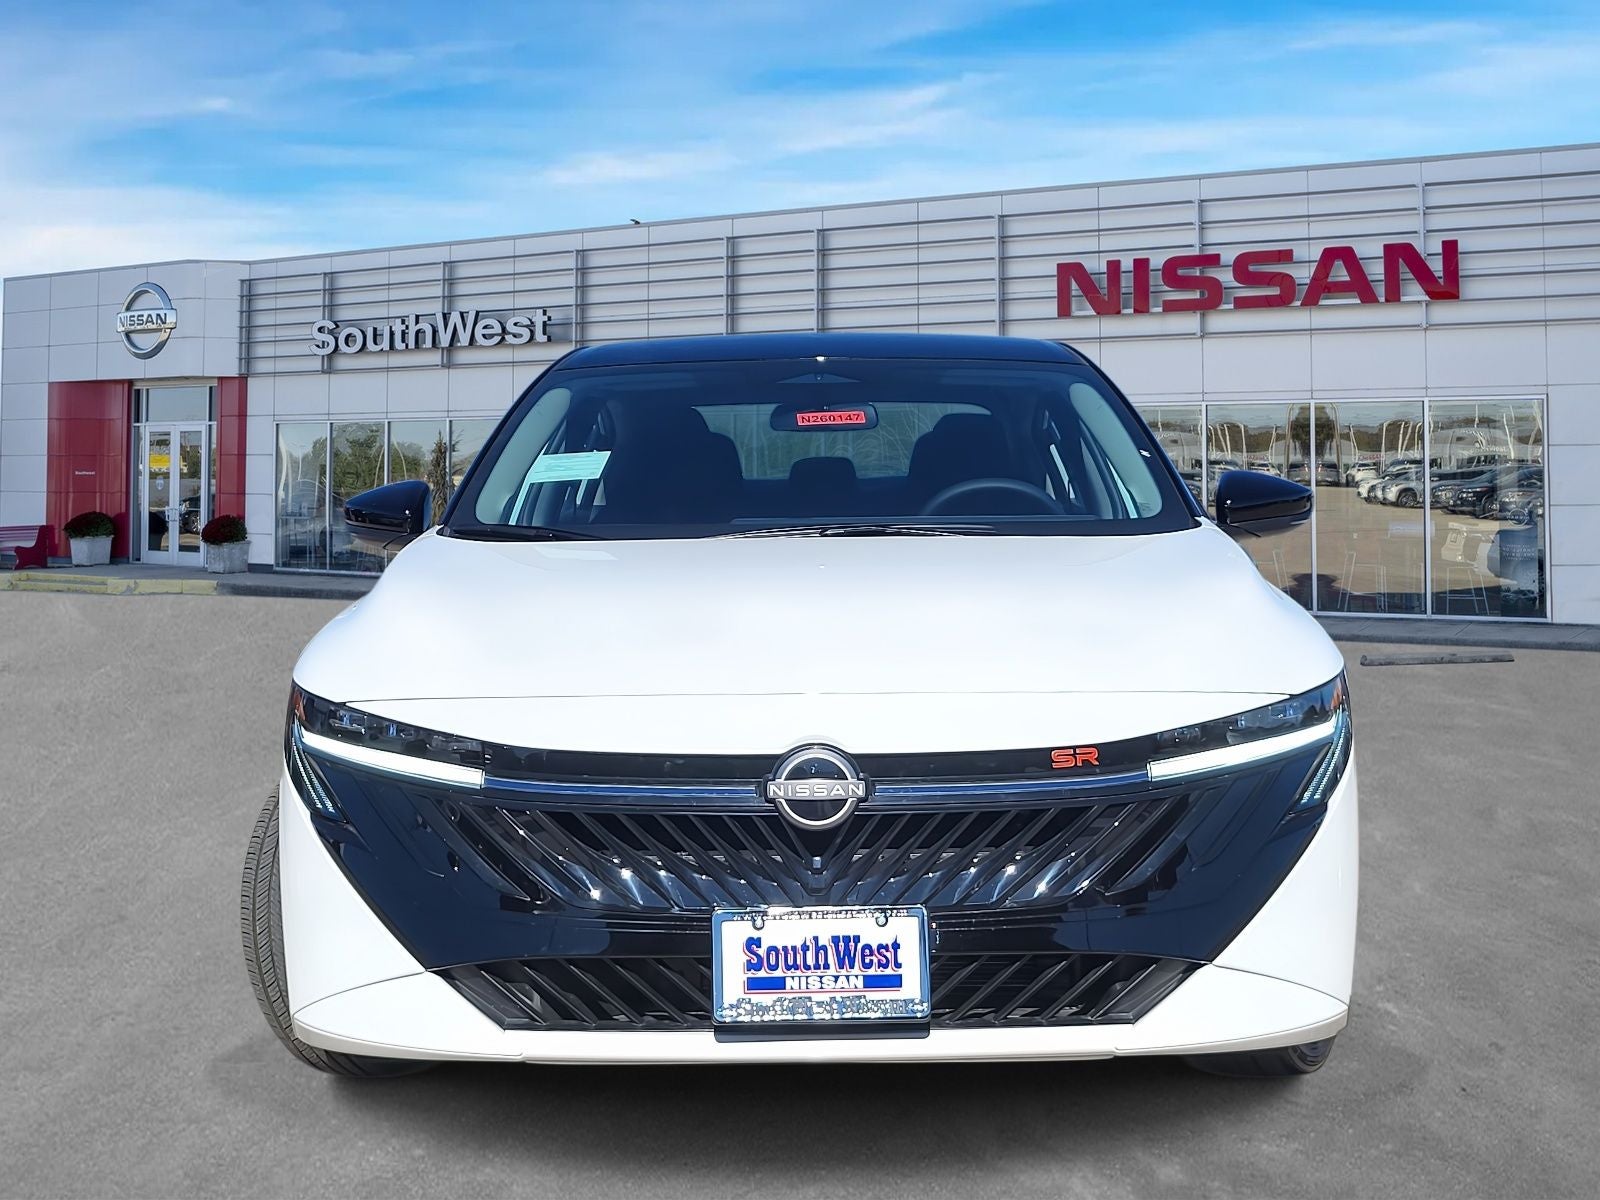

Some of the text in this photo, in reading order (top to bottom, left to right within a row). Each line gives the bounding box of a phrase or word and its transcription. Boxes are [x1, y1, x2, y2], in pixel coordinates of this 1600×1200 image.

[1056, 239, 1461, 318] NISSAN
[119, 312, 168, 328] NISSAN
[308, 308, 551, 357] SouthWest
[801, 413, 861, 424] N260147
[1050, 745, 1101, 769] SR
[768, 782, 864, 798] NISSAN
[742, 934, 903, 976] SouthWest
[785, 975, 865, 991] NISSAN
